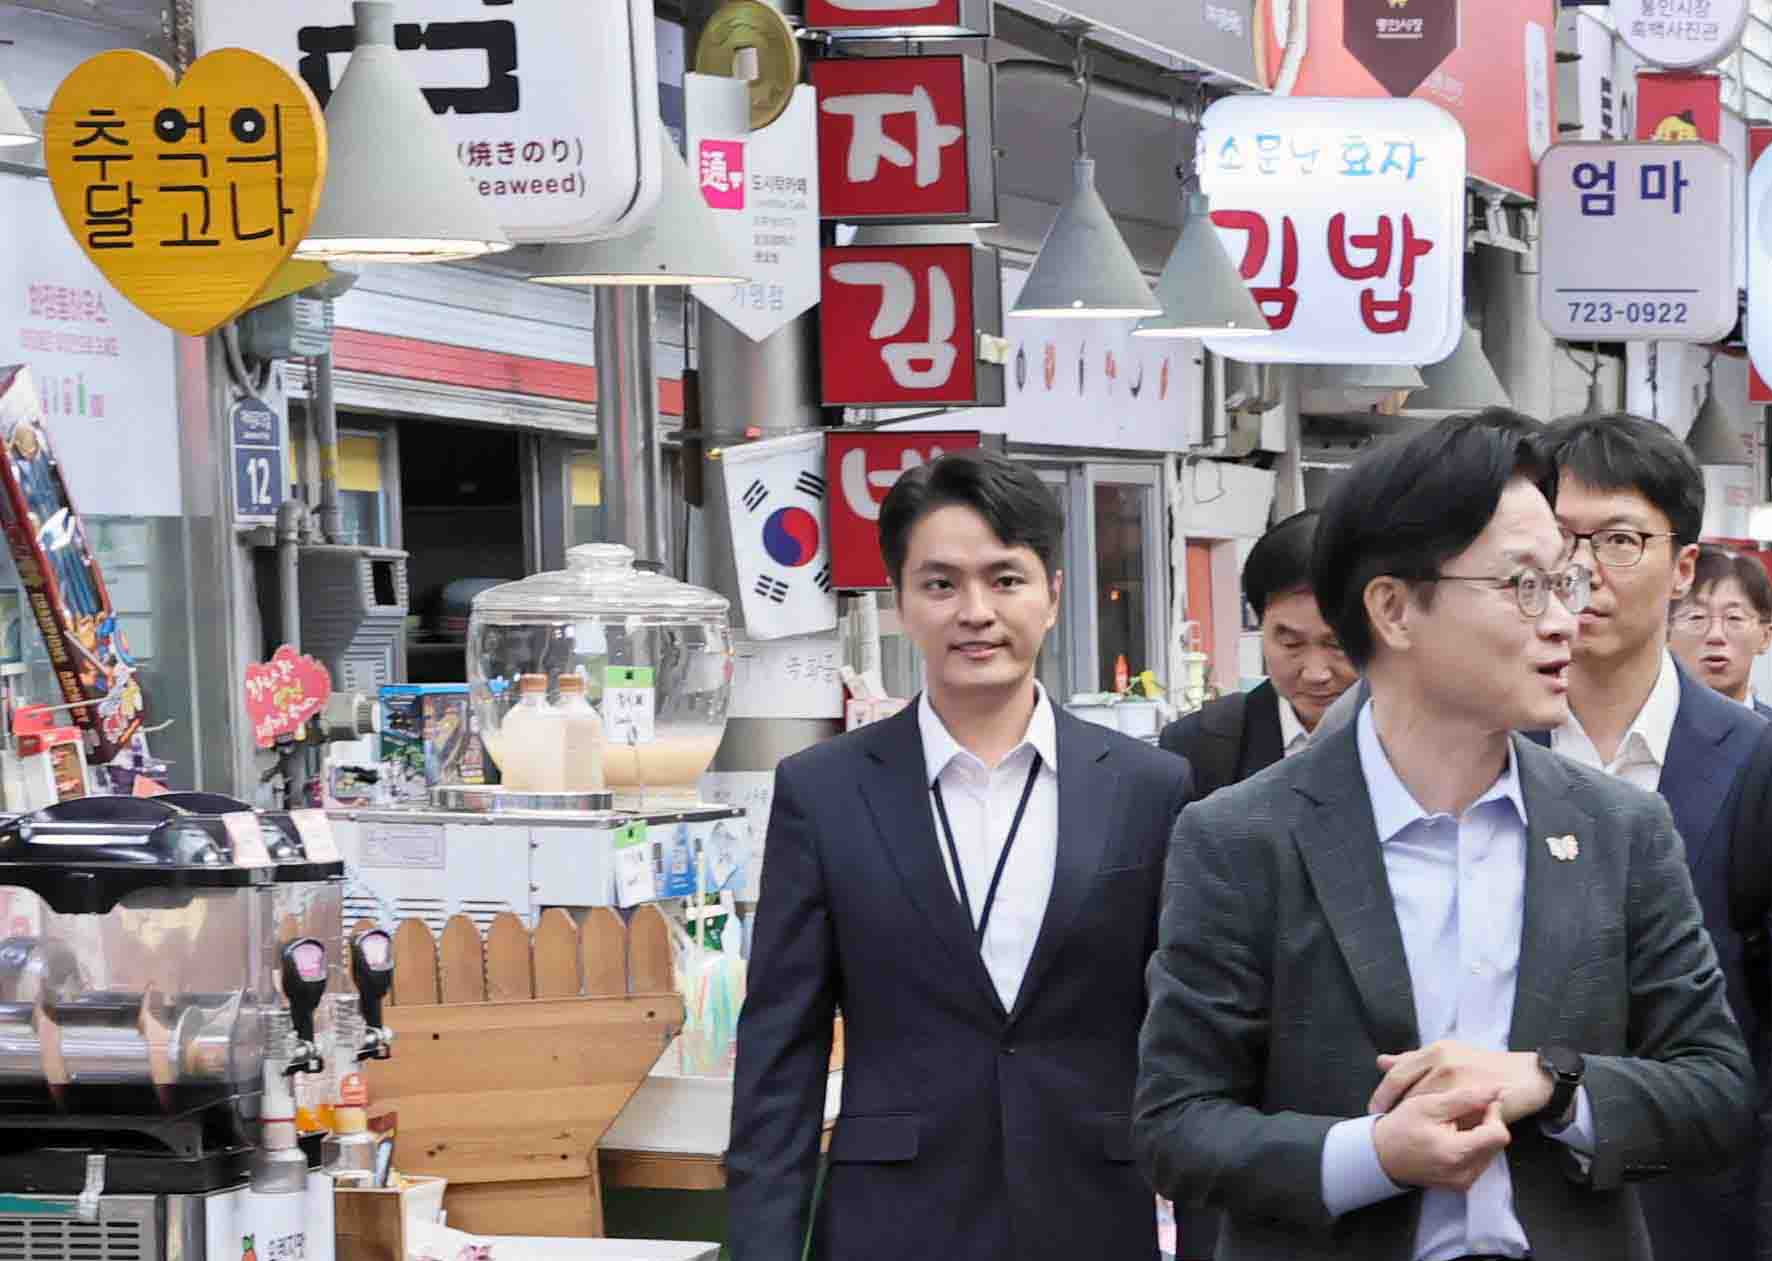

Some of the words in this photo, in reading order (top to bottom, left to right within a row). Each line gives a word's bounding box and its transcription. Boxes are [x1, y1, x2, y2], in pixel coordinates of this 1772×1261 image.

[72, 103, 284, 181] 추억의
[1218, 135, 1322, 175] 소문난
[1338, 135, 1427, 181] 효자
[470, 172, 586, 199] eaweed)
[1572, 159, 1689, 217] 엄마
[84, 178, 295, 250] 달고나
[1209, 209, 1434, 334] 김밥
[1567, 302, 1688, 325] 723-0922
[246, 457, 272, 505] 12
